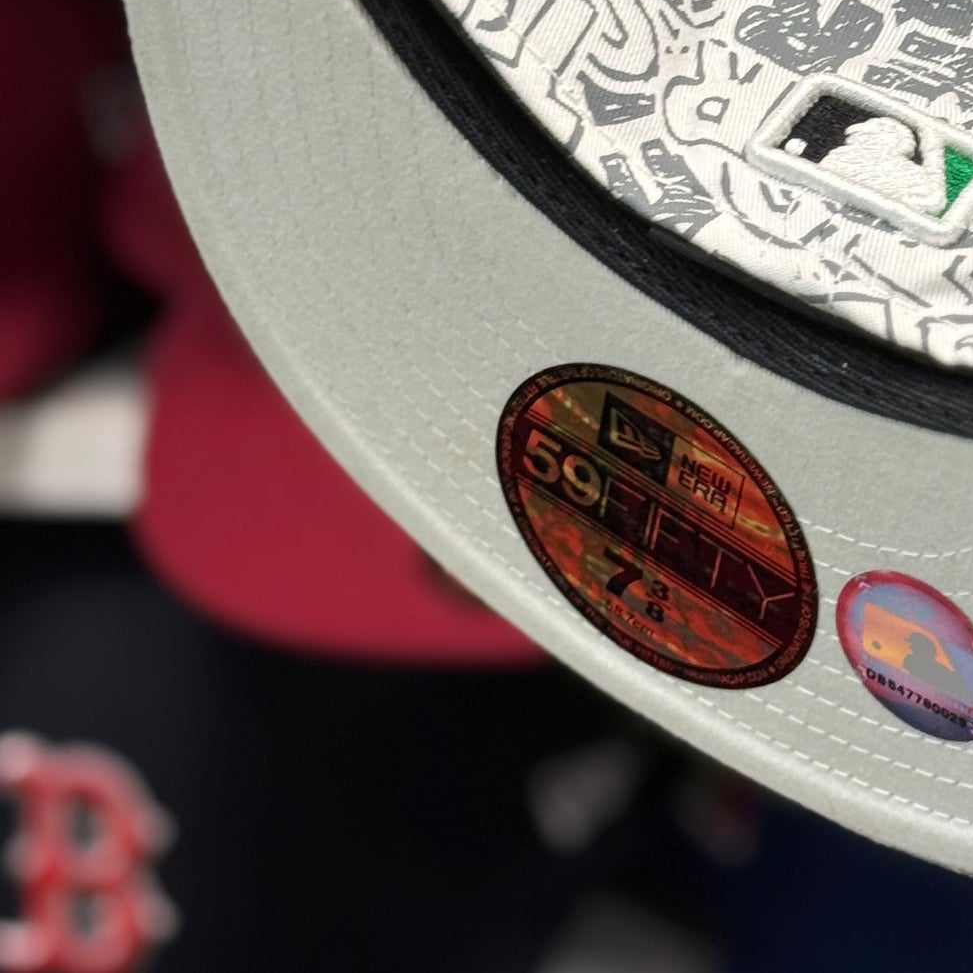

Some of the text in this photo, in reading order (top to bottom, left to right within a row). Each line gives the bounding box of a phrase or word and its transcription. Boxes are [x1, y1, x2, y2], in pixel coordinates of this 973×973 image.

[677, 468, 728, 516] ERA
[679, 452, 733, 497] NEW
[522, 429, 796, 621] 59FIFTY
[604, 545, 644, 599] 7
[0, 731, 180, 973] B
